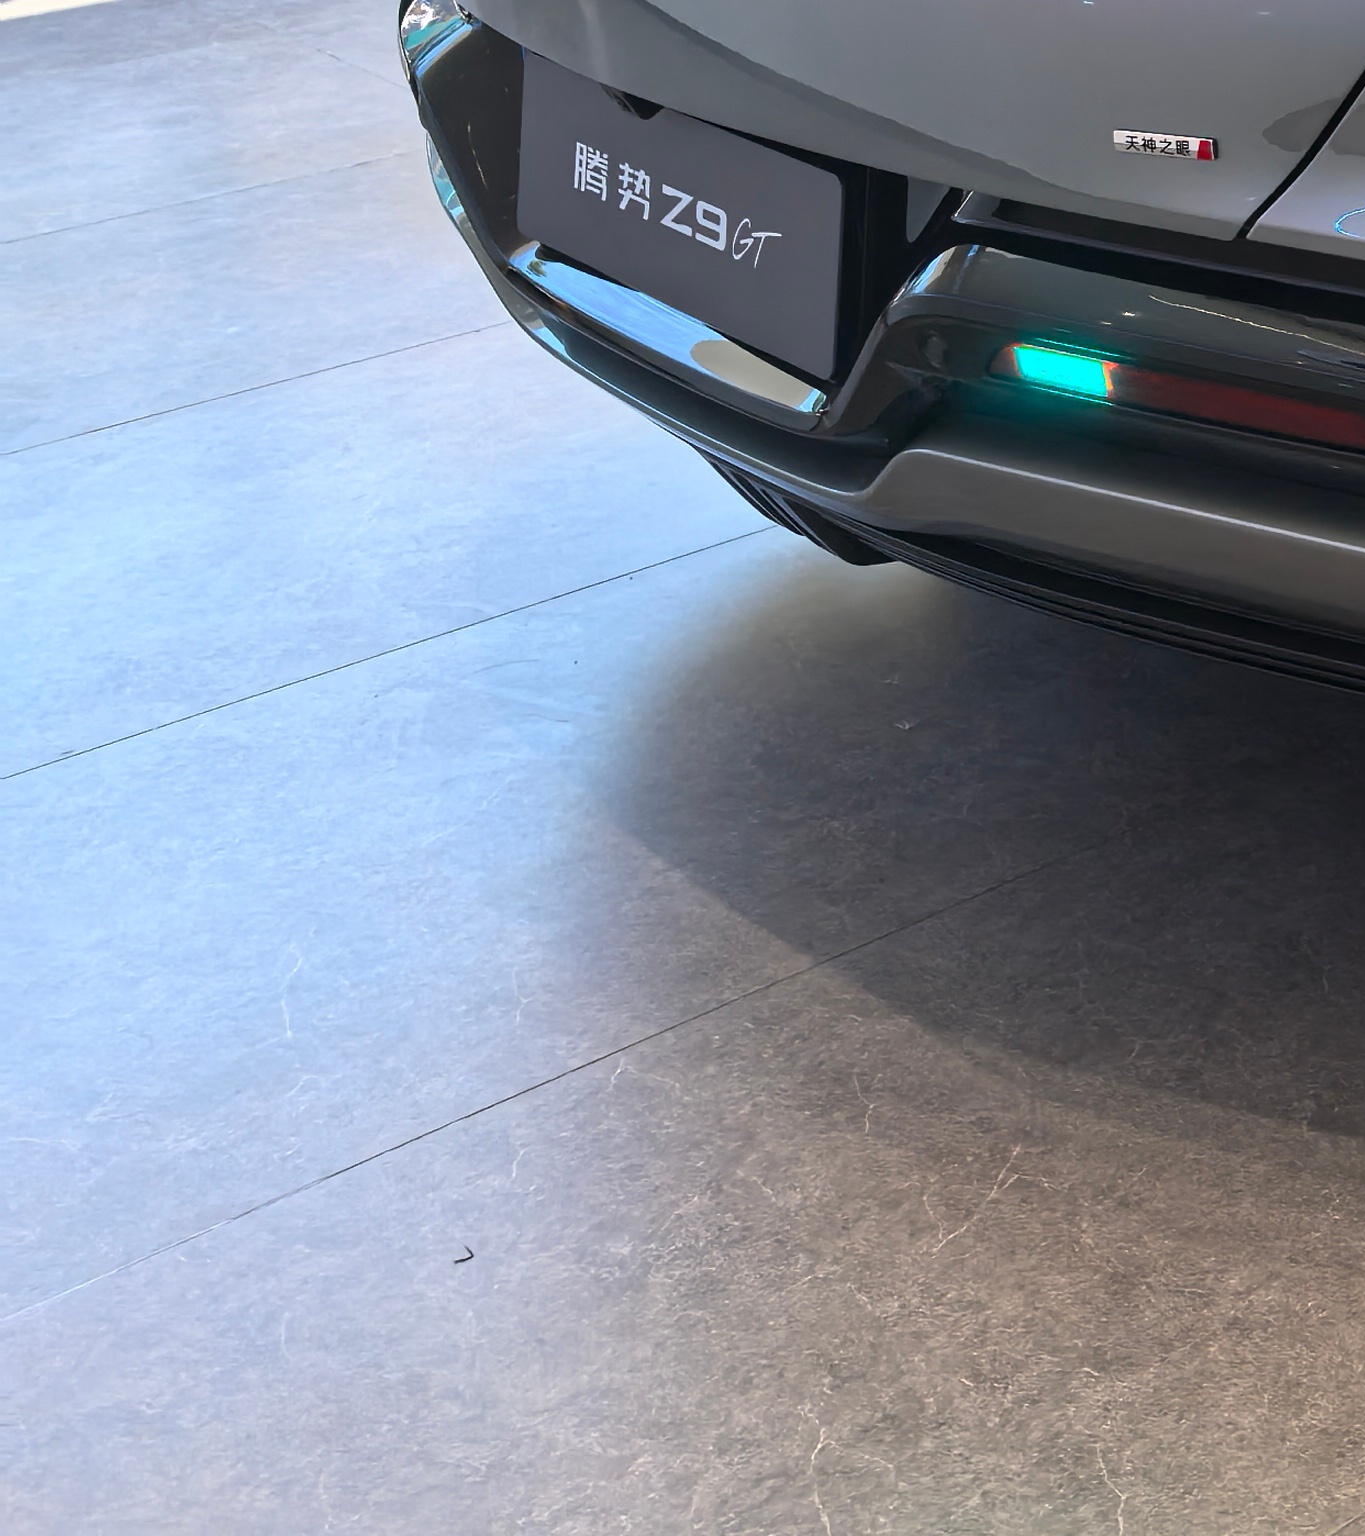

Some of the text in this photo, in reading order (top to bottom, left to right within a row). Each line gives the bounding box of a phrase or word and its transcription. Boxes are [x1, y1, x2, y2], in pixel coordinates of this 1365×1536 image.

[1125, 134, 1192, 157] 天神之眼
[573, 141, 650, 221] 腾势
